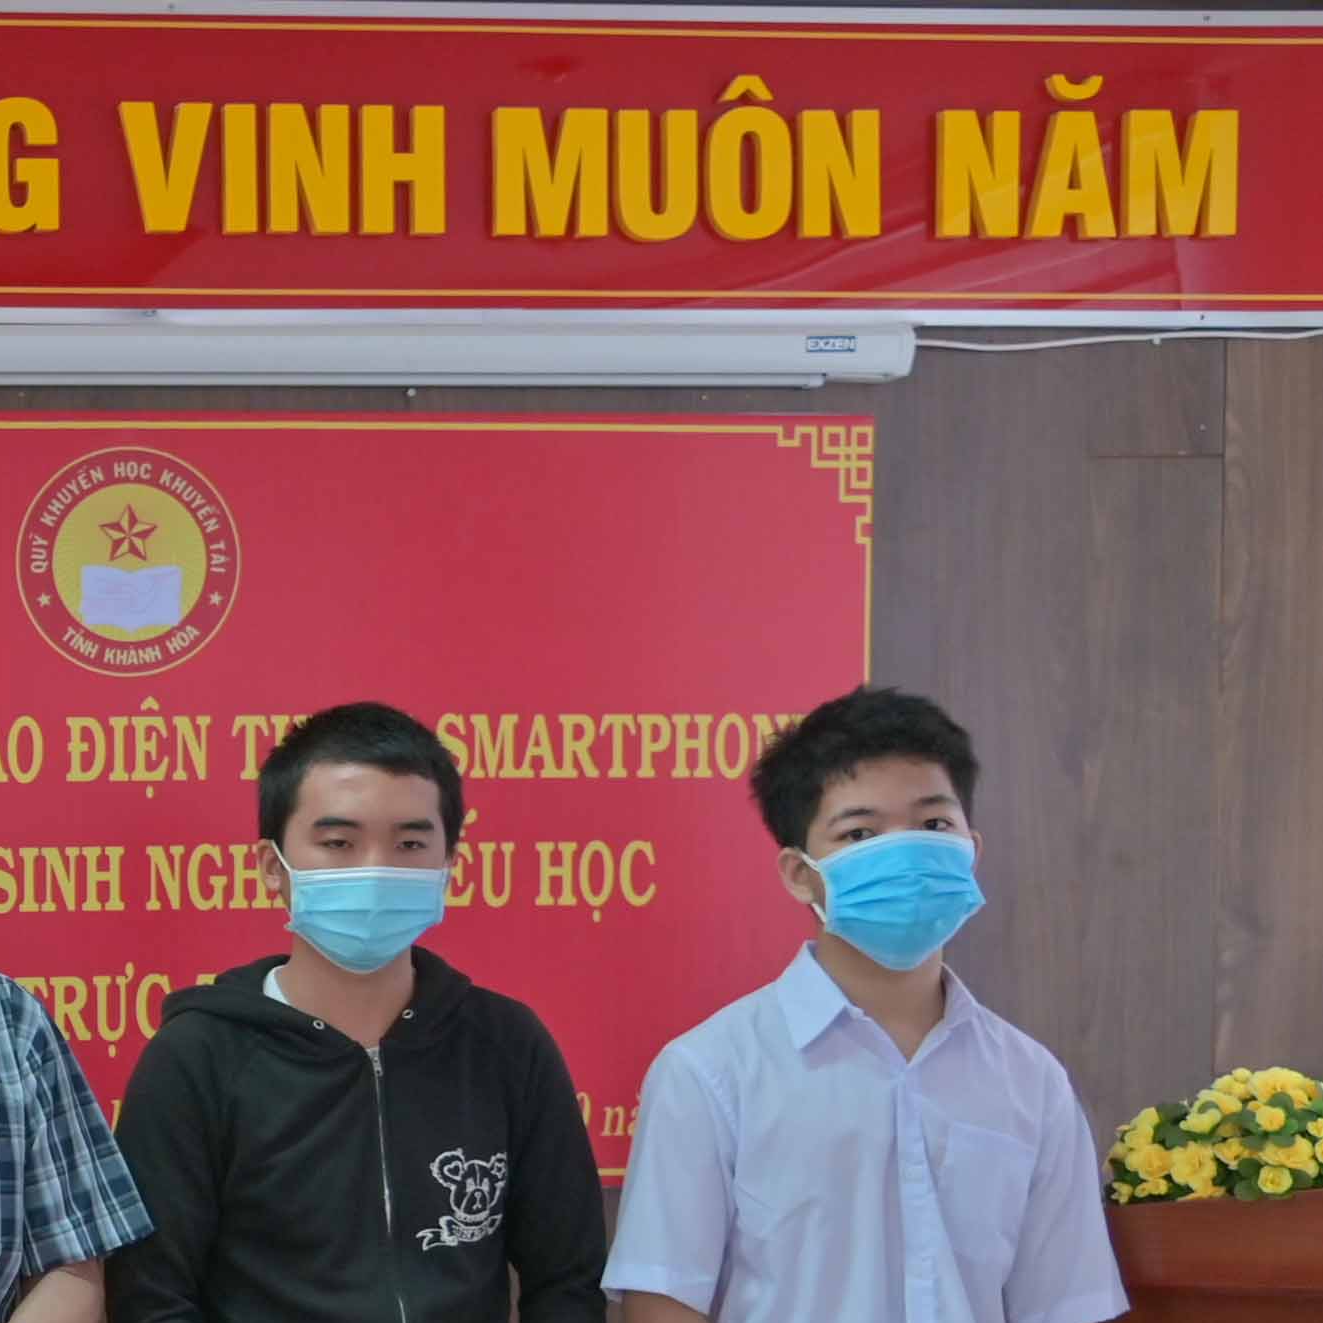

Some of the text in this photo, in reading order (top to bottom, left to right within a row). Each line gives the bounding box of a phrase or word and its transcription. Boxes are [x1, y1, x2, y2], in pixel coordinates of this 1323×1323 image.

[120, 101, 446, 235] VINH
[492, 75, 881, 241] MUÔN
[935, 74, 1239, 238] NĂM
[113, 461, 152, 481] HỌC
[65, 696, 212, 799] ĐIỆN
[435, 712, 810, 780] SMARTPHON
[146, 842, 287, 911] NGH
[536, 840, 657, 923] HỌC
